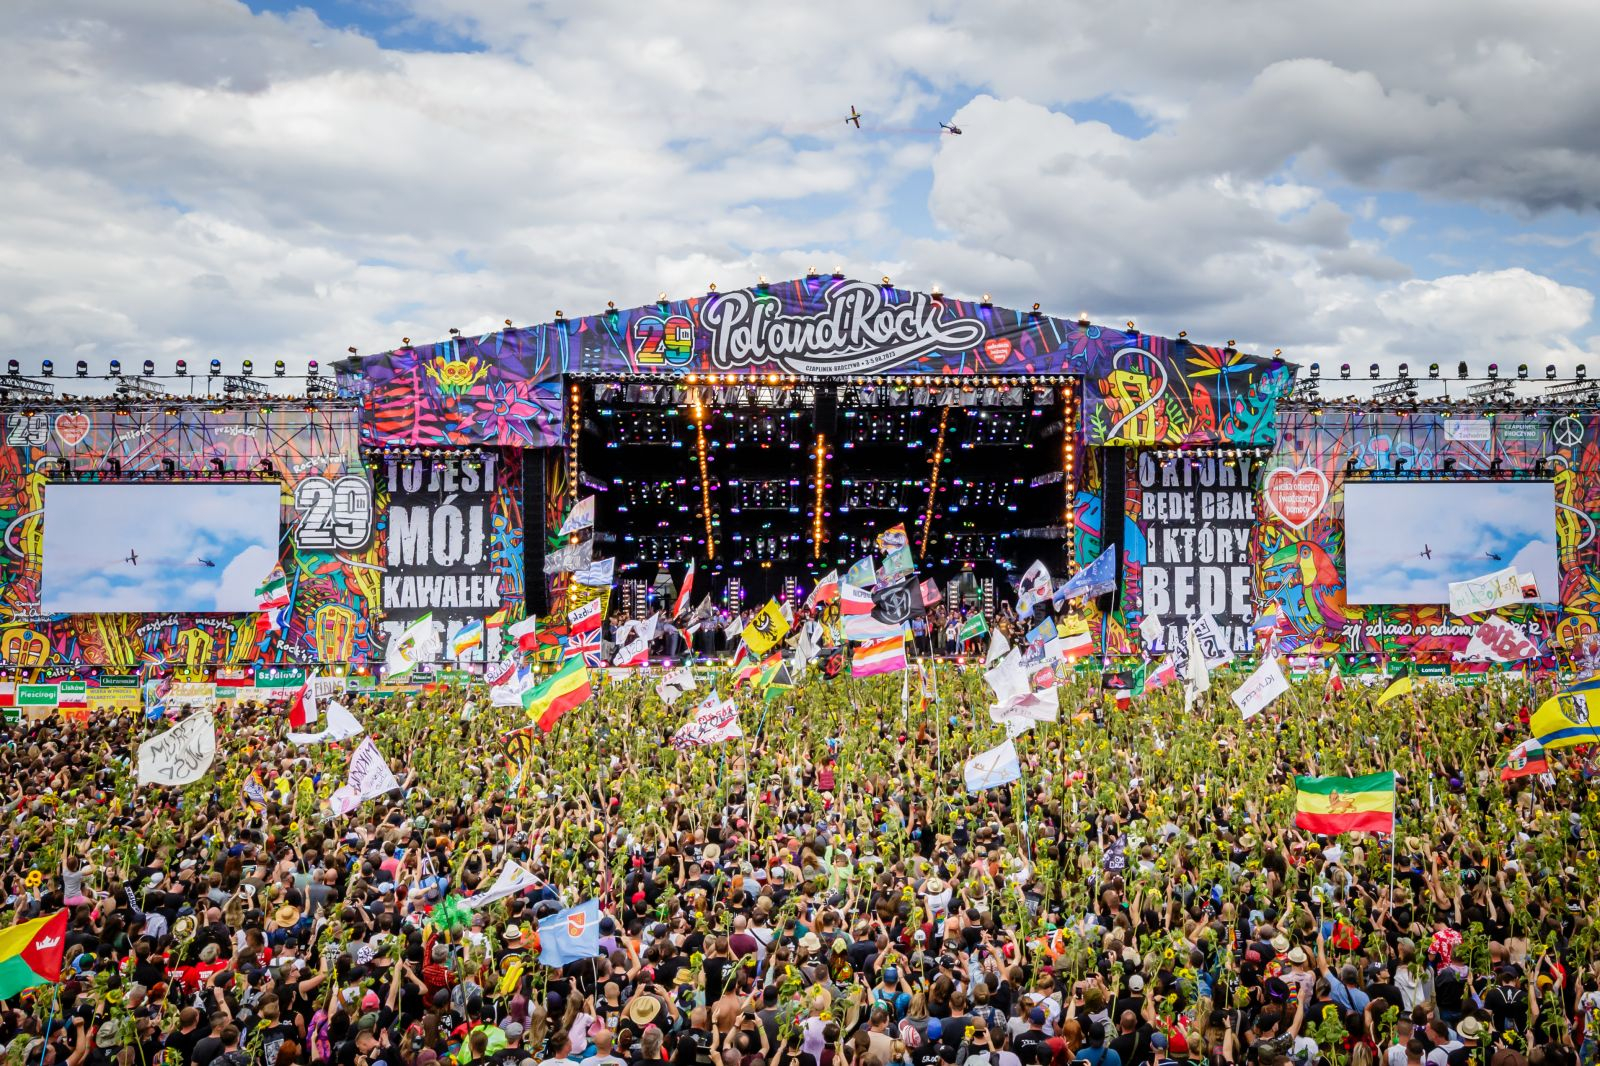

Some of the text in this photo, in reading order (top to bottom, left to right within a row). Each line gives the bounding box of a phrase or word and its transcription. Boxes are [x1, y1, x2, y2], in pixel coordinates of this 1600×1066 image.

[1142, 491, 1196, 525] BĘDĘ
[1286, 505, 1310, 517] pomocy
[388, 494, 486, 568] MÓJ
[383, 575, 502, 609] KAWAŁEK
[1142, 566, 1252, 624] BĘDĘ
[1365, 616, 1412, 637] zdrowo
[61, 683, 85, 691] Lisków
